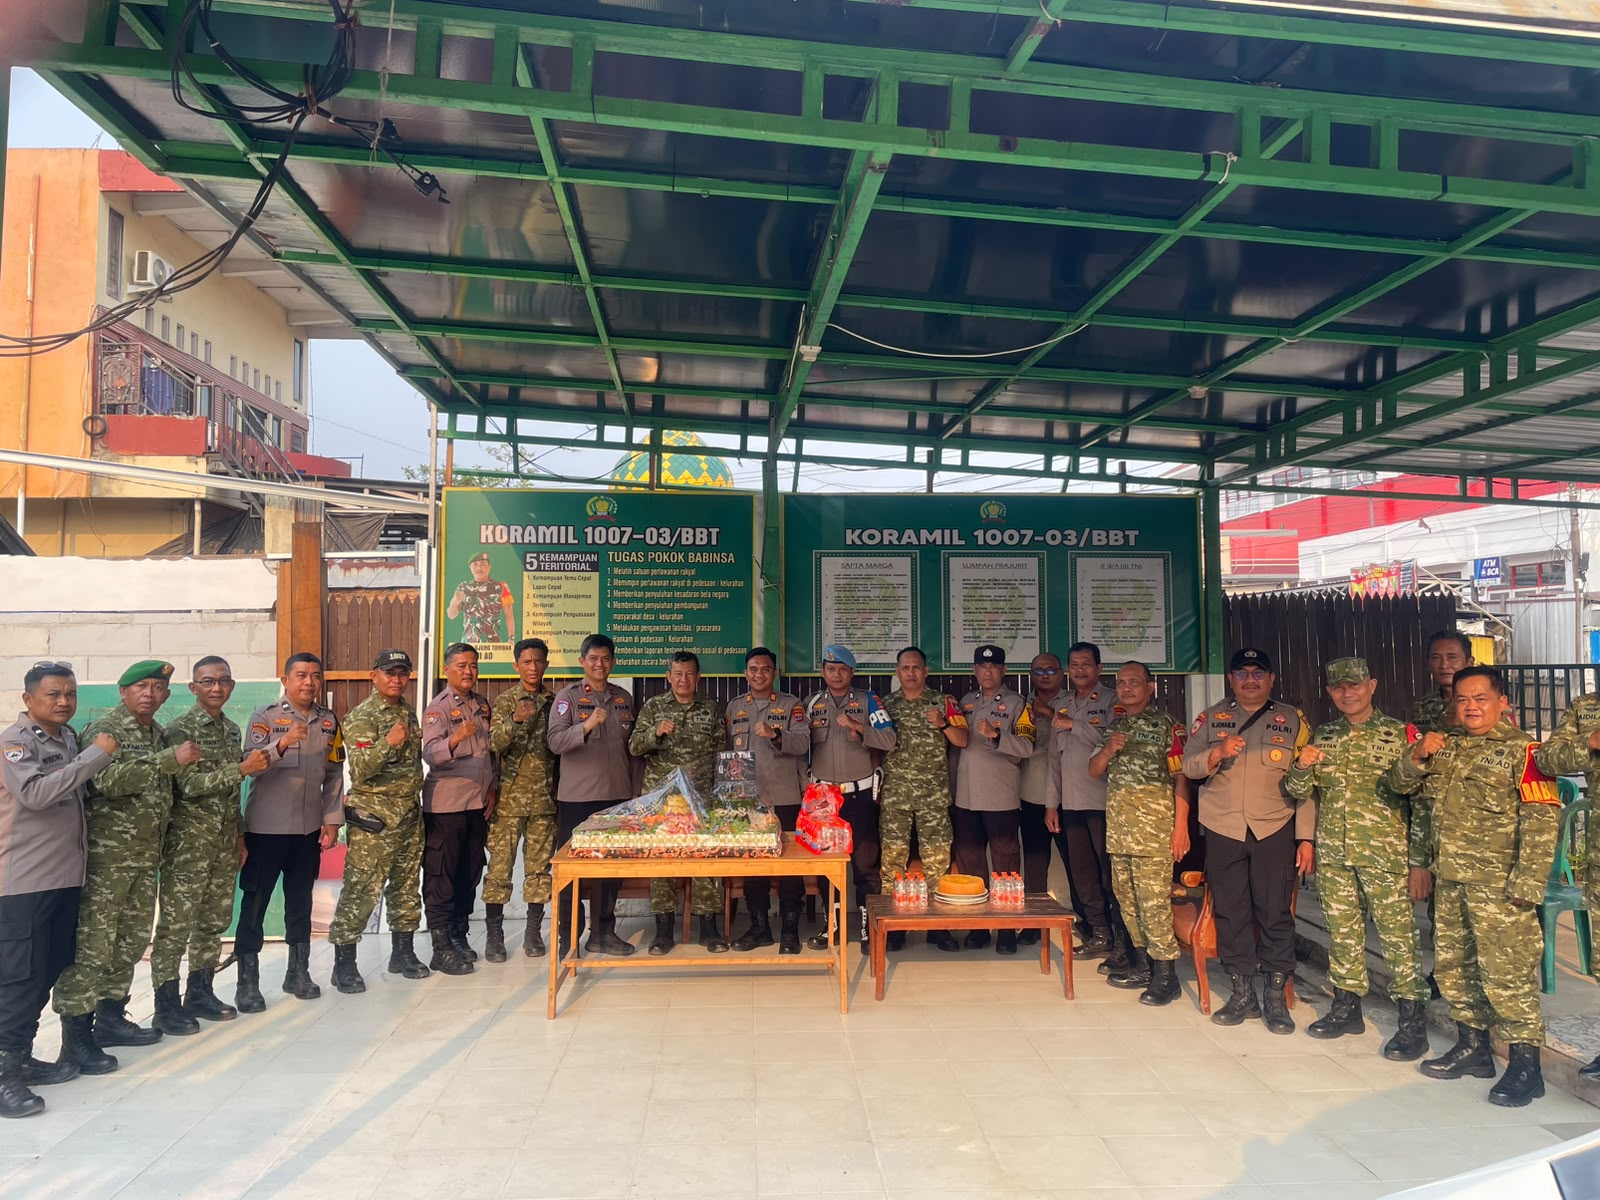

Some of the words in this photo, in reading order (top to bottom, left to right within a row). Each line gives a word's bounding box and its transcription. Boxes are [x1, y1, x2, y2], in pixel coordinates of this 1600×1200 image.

[480, 524, 579, 545] KORAMIL
[584, 525, 720, 547] 1007-03/BBT
[845, 528, 965, 546] KORAMIL
[972, 528, 1140, 548] 1007-03/BBT
[525, 553, 538, 571] 5
[539, 553, 598, 562] KEMAMPUAN
[608, 551, 645, 563] TUGAS
[647, 552, 685, 563] POKOK
[688, 552, 735, 564] BABINSA
[540, 562, 592, 571] TERITORIAL
[865, 562, 894, 570] MARGA
[1482, 559, 1496, 568] ATM
[613, 567, 632, 575] Melatih
[633, 567, 650, 575] satuan
[651, 567, 679, 577] perlawanan
[680, 567, 696, 577] rakyat
[640, 578, 669, 588] perlawanan
[670, 579, 685, 588] rakyat
[686, 579, 692, 587] di
[692, 579, 716, 588] pedesaan
[720, 579, 744, 587] kelurahan
[613, 590, 644, 599] Memberikan
[645, 590, 673, 600] penyuluhan
[674, 590, 699, 599] kesadaran
[700, 590, 711, 599] bela
[712, 591, 729, 601] negara
[613, 601, 644, 609] Memberikan
[645, 601, 673, 611] penyuluhan
[674, 601, 708, 611] pembangunan
[613, 612, 642, 622] masyarakat
[643, 612, 655, 620] desa
[659, 612, 684, 620] kelurahan
[613, 623, 640, 632] Melakukan
[640, 623, 671, 633] pengawasan
[672, 623, 692, 632] fasilitas
[696, 624, 721, 633] prasarana
[613, 635, 633, 643] Hankam
[634, 635, 639, 643] di
[640, 635, 664, 644] pedesaan
[668, 635, 693, 643] Kelurahan
[644, 647, 663, 656] laporan
[702, 647, 717, 655] sosial
[718, 647, 723, 655] di
[723, 647, 747, 656] pedesaan
[641, 658, 658, 666] secara
[990, 711, 1009, 719] POLRI
[1266, 724, 1292, 734] POLRI
[1137, 732, 1149, 740] TNI
[1151, 734, 1161, 742] AD
[1388, 746, 1401, 754] AD
[1479, 756, 1495, 766] TNI
[1497, 759, 1511, 769] AD
